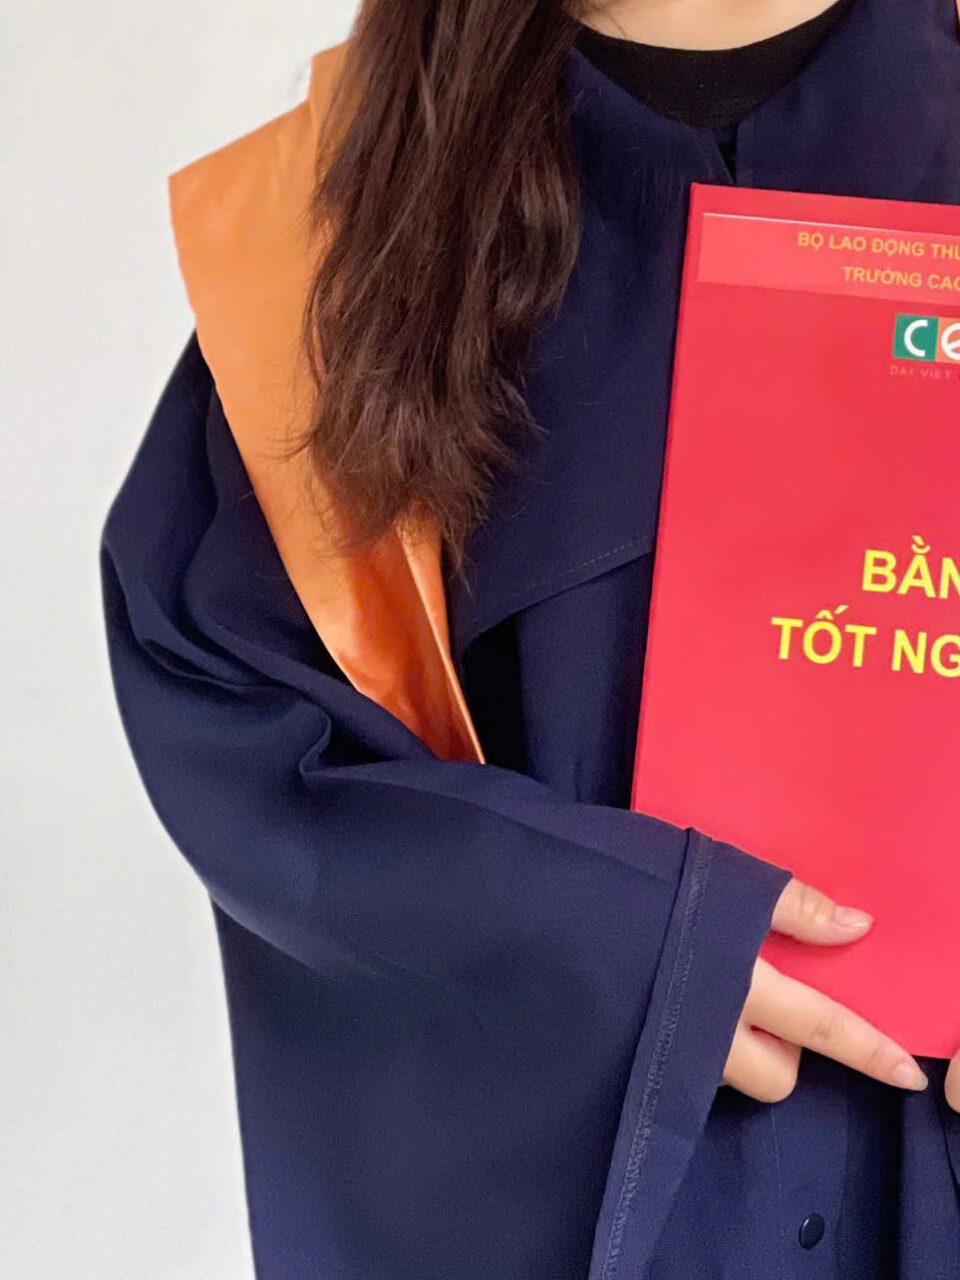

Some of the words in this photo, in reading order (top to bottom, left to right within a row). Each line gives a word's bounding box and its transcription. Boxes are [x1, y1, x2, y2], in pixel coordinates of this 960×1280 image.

[829, 235, 867, 252] LAO
[844, 266, 922, 288] TRƯỜNG
[770, 605, 878, 668] TỐT
